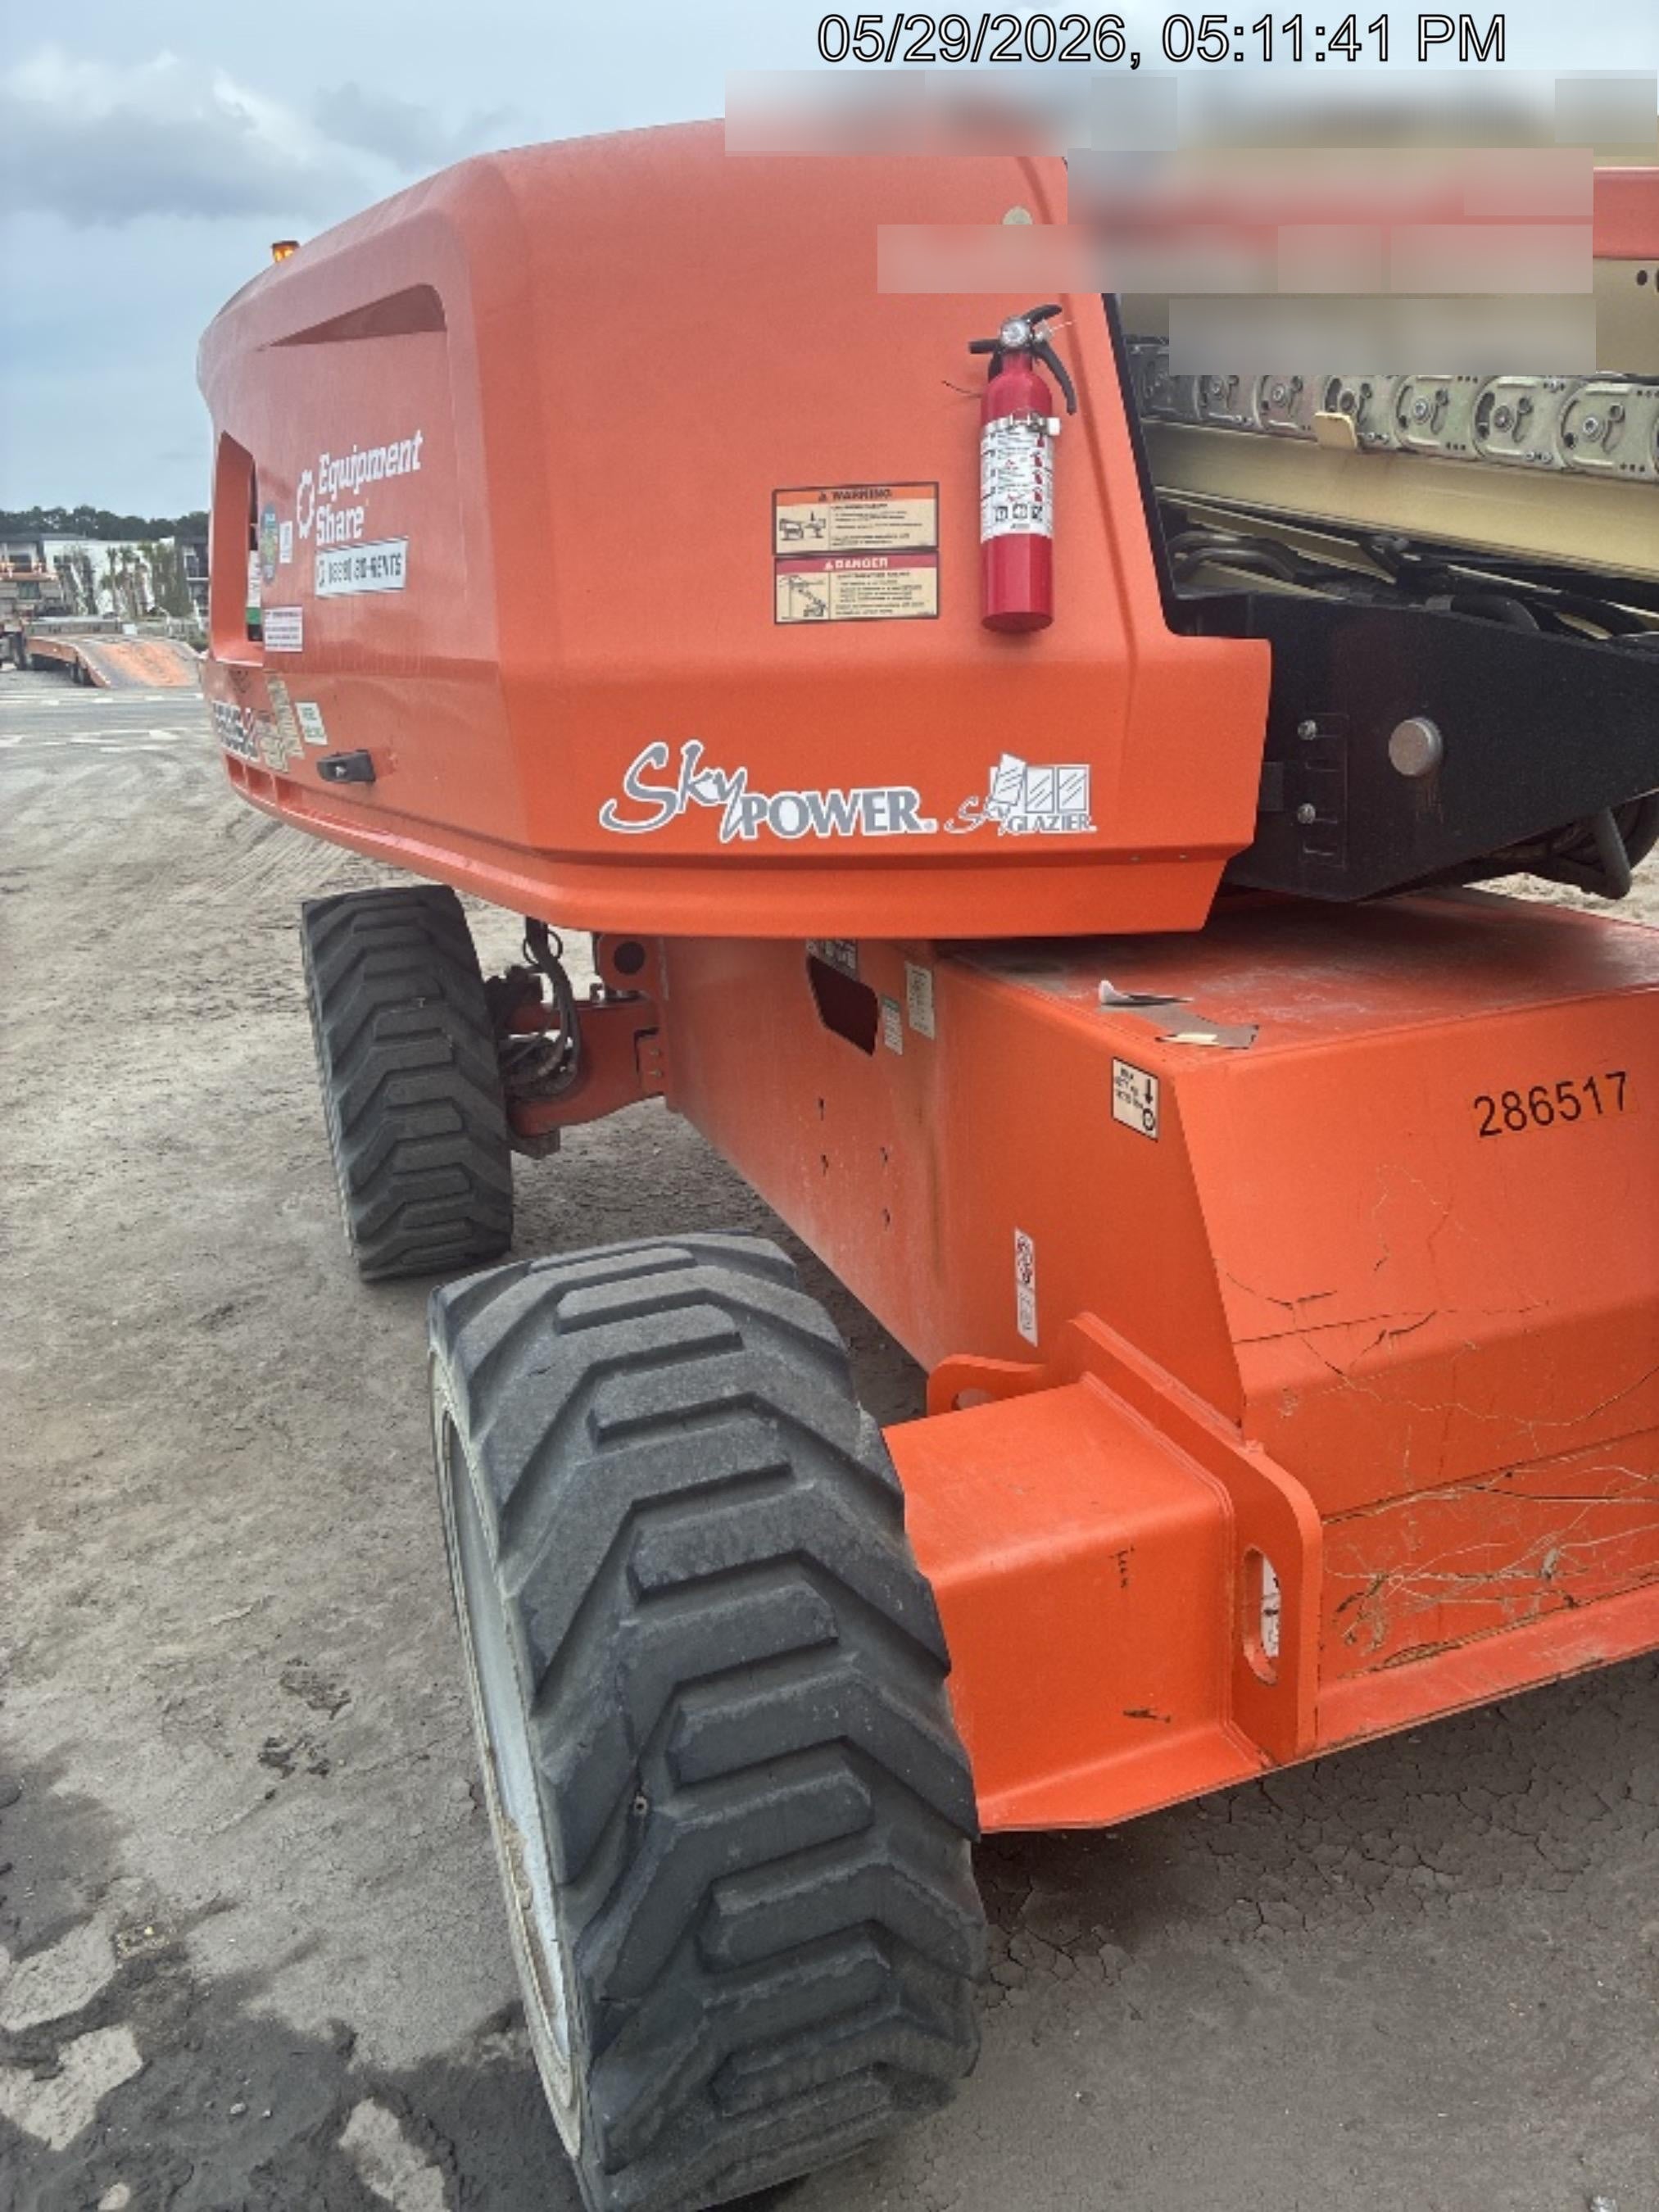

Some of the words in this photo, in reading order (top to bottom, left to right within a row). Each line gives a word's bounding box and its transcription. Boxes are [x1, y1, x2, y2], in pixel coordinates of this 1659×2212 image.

[317, 429, 424, 501] Equipment
[832, 488, 892, 501] WARNING
[316, 503, 365, 546] Share
[835, 556, 889, 569] DANGER
[1474, 1071, 1626, 1138] 286517
